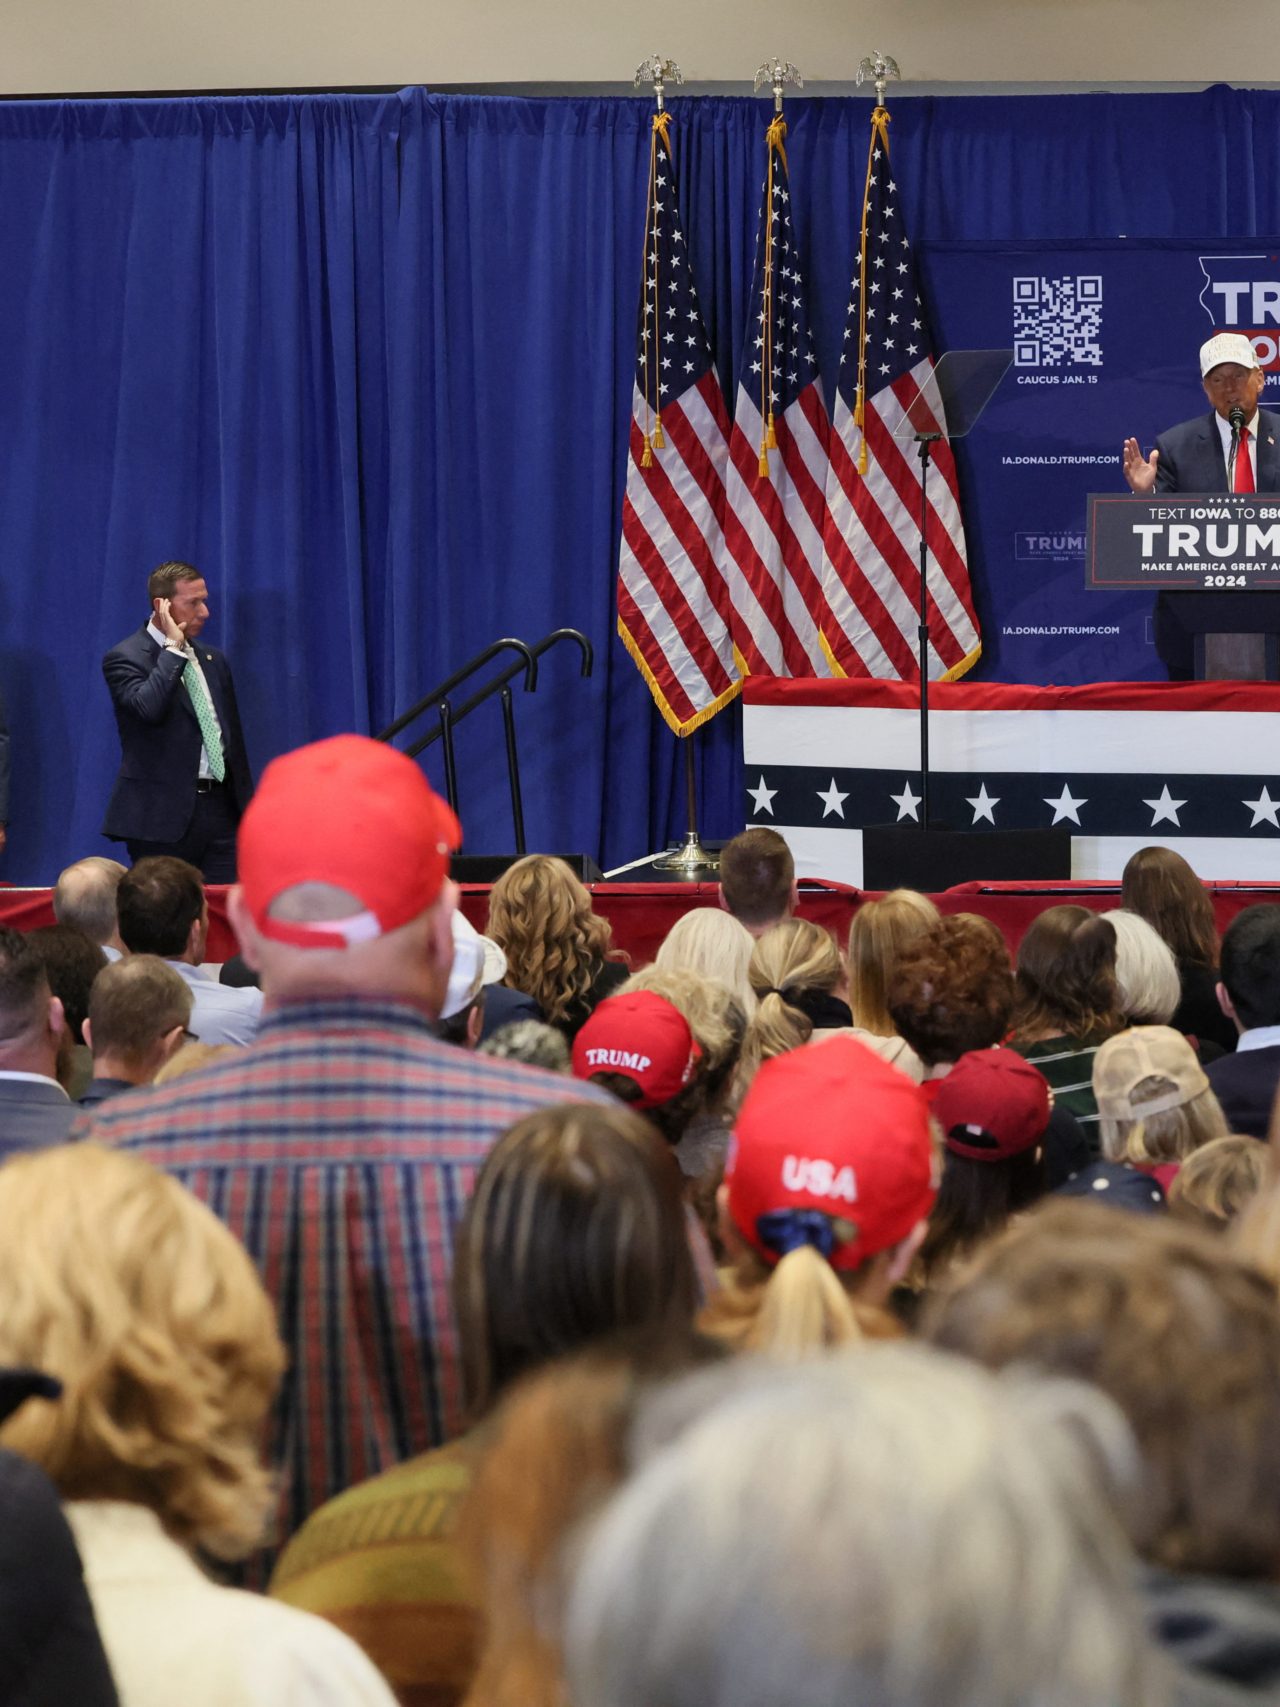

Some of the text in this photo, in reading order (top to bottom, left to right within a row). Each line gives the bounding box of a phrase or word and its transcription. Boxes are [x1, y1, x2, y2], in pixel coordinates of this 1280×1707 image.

[1017, 375, 1098, 384] CAUCUS JAN. 15
[1002, 456, 1120, 465] IA.DONALDJTRUMP.COM
[1149, 508, 1185, 519] TEXT
[1190, 508, 1231, 519] IOWA
[1235, 508, 1256, 519] TO
[1025, 537, 1087, 550] TRUM
[1141, 563, 1173, 571] MAKE
[1176, 563, 1227, 571] AMERICA
[1231, 563, 1267, 571] GREAT
[1204, 575, 1247, 587] 2024
[1002, 626, 1120, 635] IA.DONALDJTRUMP.COM
[585, 1048, 651, 1072] TRUMP
[781, 1154, 857, 1204] USA
